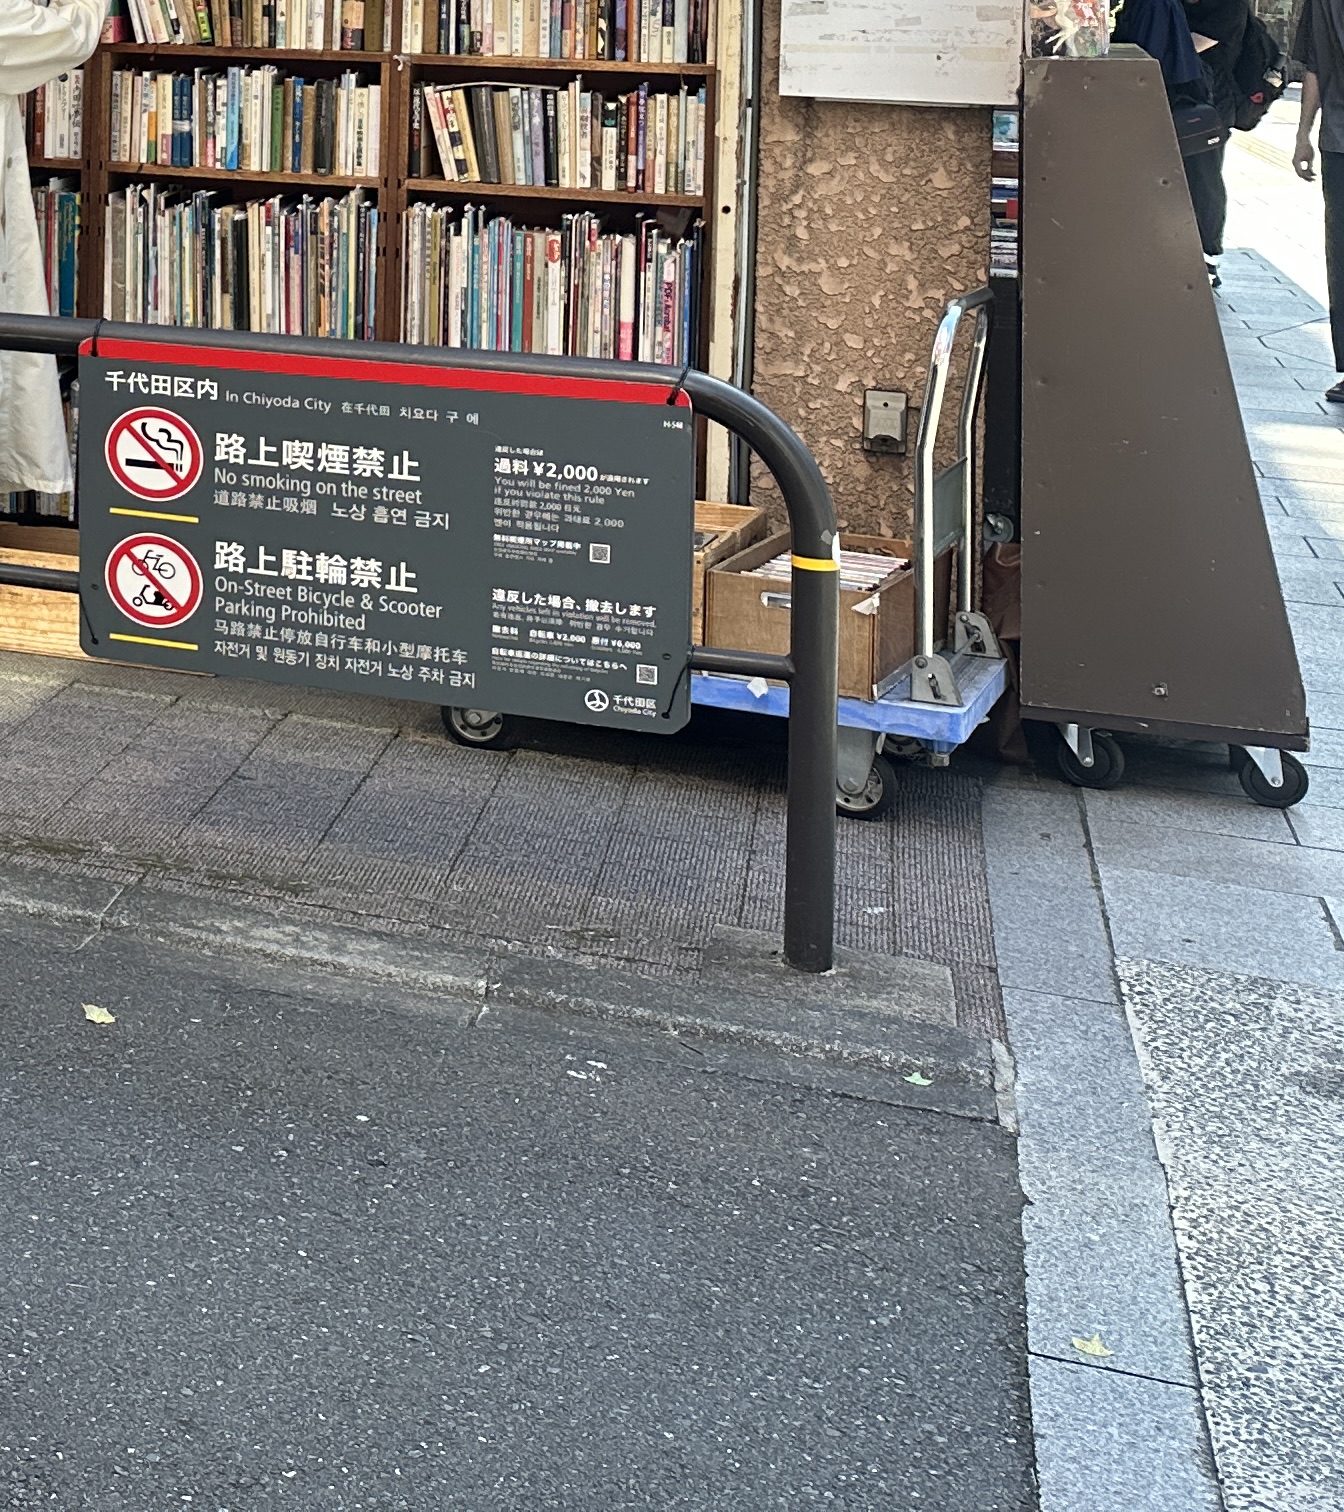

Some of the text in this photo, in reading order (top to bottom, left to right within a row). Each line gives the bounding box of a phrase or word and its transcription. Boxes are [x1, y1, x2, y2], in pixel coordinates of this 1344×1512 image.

[104, 370, 219, 401] 千代田区内
[225, 390, 332, 414] In Chiyoda City
[399, 407, 439, 422] 치요다
[214, 432, 421, 483] 路上喫煙禁止
[494, 457, 599, 482] 過料 ¥2,000
[214, 468, 423, 505] No smoking on the street
[494, 476, 515, 487] You
[517, 478, 536, 488] will
[538, 479, 551, 490] be
[554, 482, 581, 493] fined
[615, 487, 635, 498] Yen
[504, 488, 523, 499] you
[525, 489, 561, 501] violate
[563, 492, 582, 503] this
[584, 495, 605, 505] rule
[214, 489, 318, 516] 道路禁止吸烟
[330, 502, 450, 530] 노상 흡연 금지
[214, 541, 418, 593] 路上駐輪禁止
[214, 576, 443, 619] On-Street Bicycle & Scooter
[214, 597, 366, 631] Parking Prohibited
[214, 619, 469, 665] 马路禁止停放自行车和小型摩托车
[214, 639, 251, 659] 자전거
[273, 647, 310, 668] 원동기
[314, 652, 341, 672] 장치
[344, 656, 383, 677] 자전거
[387, 661, 414, 681] 노상
[418, 666, 445, 685] 주차
[448, 670, 476, 690] 금지
[613, 694, 657, 710] 千代田区
